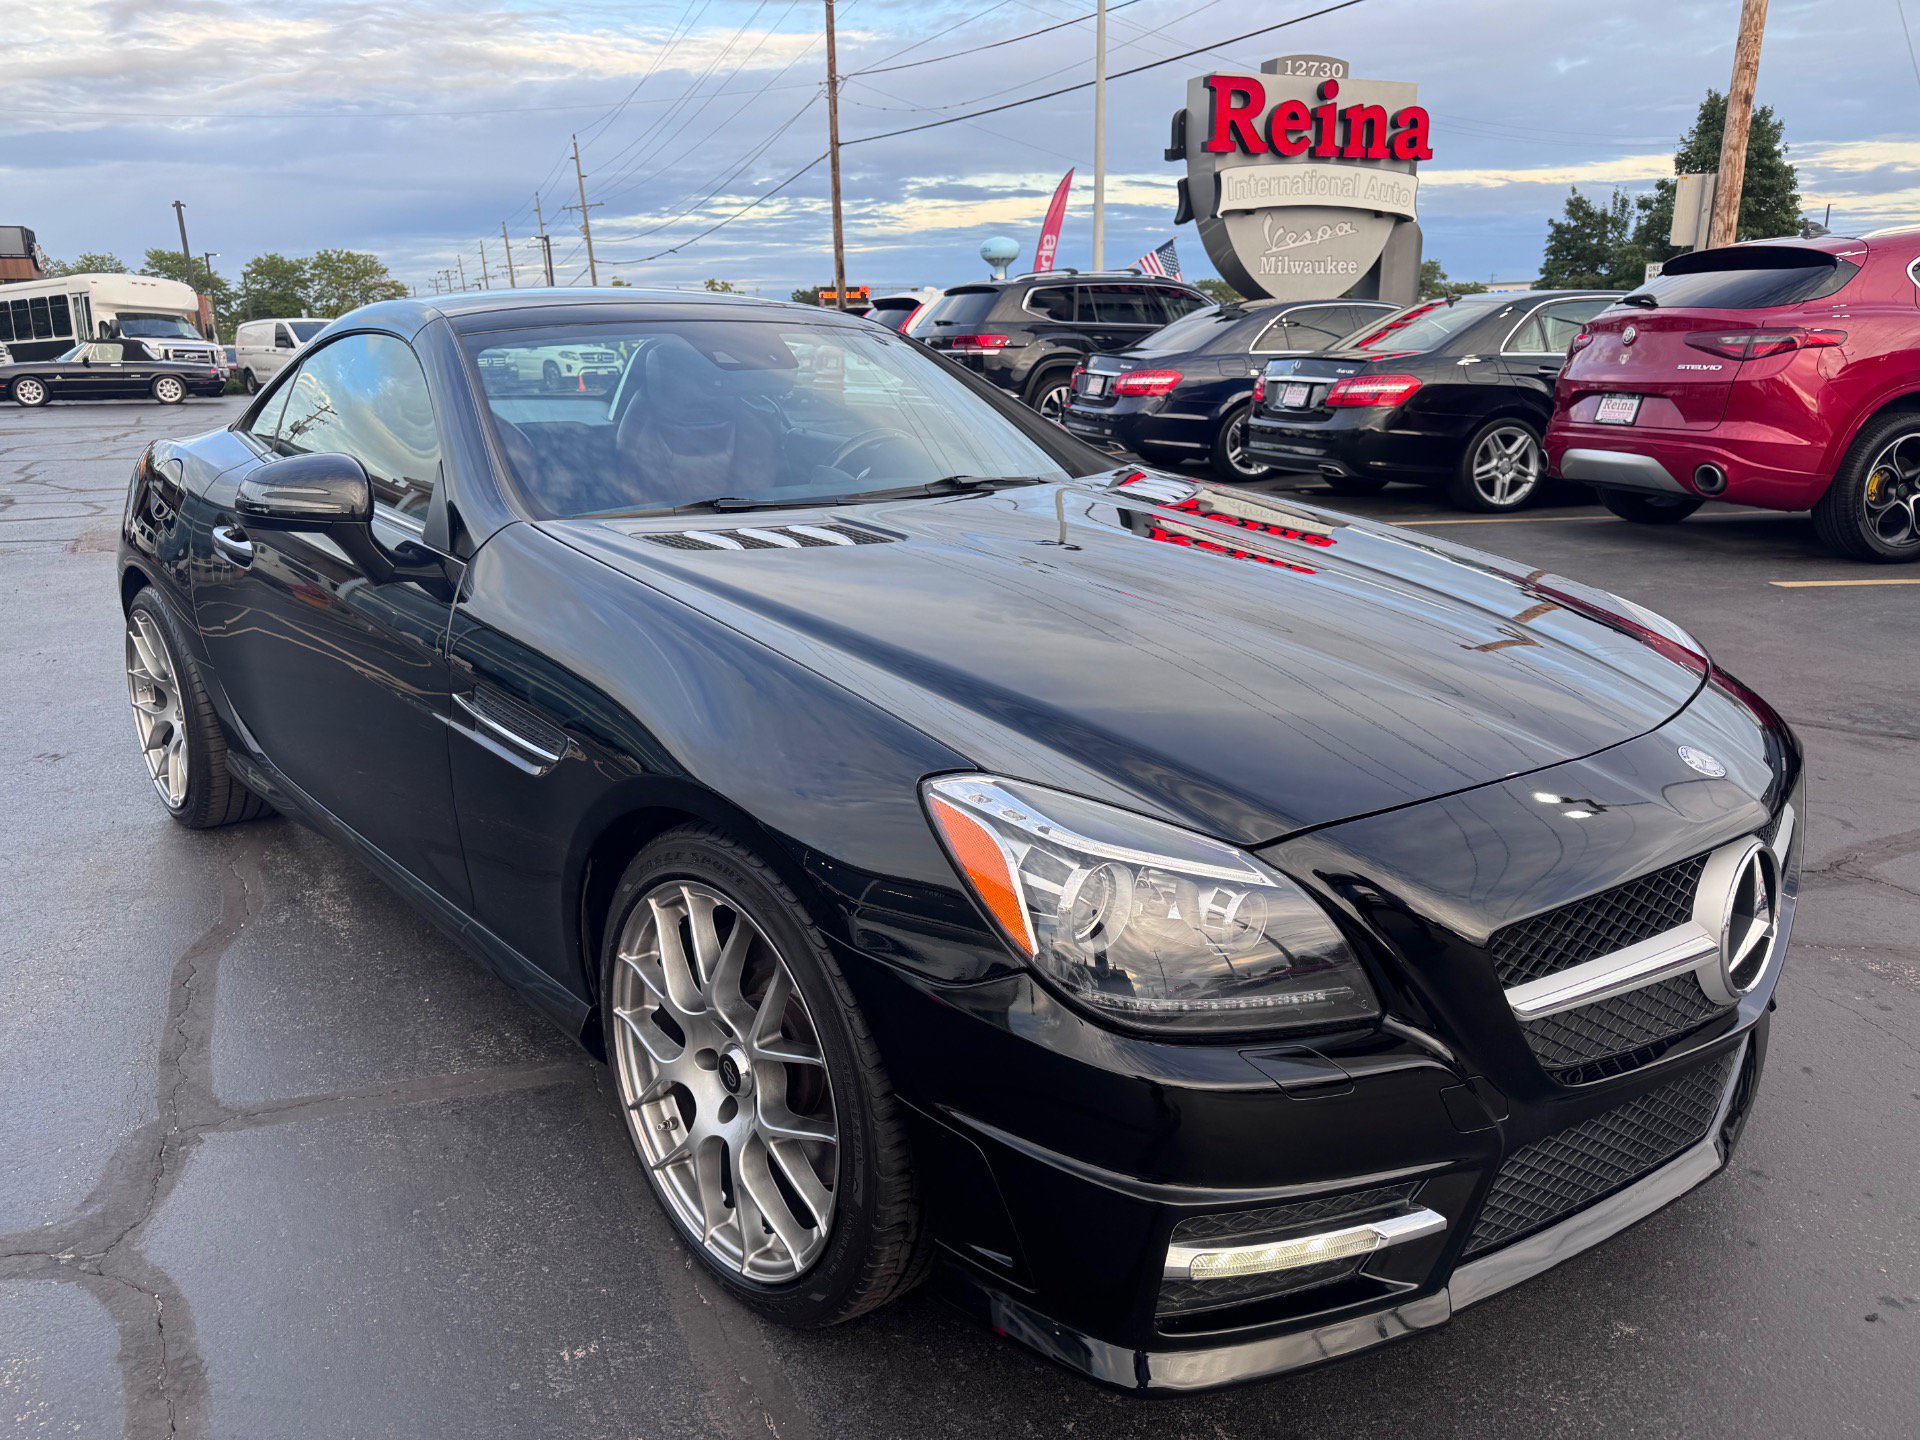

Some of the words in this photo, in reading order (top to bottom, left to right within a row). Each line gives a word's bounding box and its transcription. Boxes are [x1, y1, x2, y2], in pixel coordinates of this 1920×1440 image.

[1284, 60, 1344, 78] 12730
[1203, 75, 1433, 161] Reina
[1227, 169, 1360, 201] International
[1364, 174, 1411, 207] Auto
[1262, 212, 1359, 254] Vespa
[1258, 256, 1359, 275] Milwaukee
[1603, 400, 1635, 411] Reina
